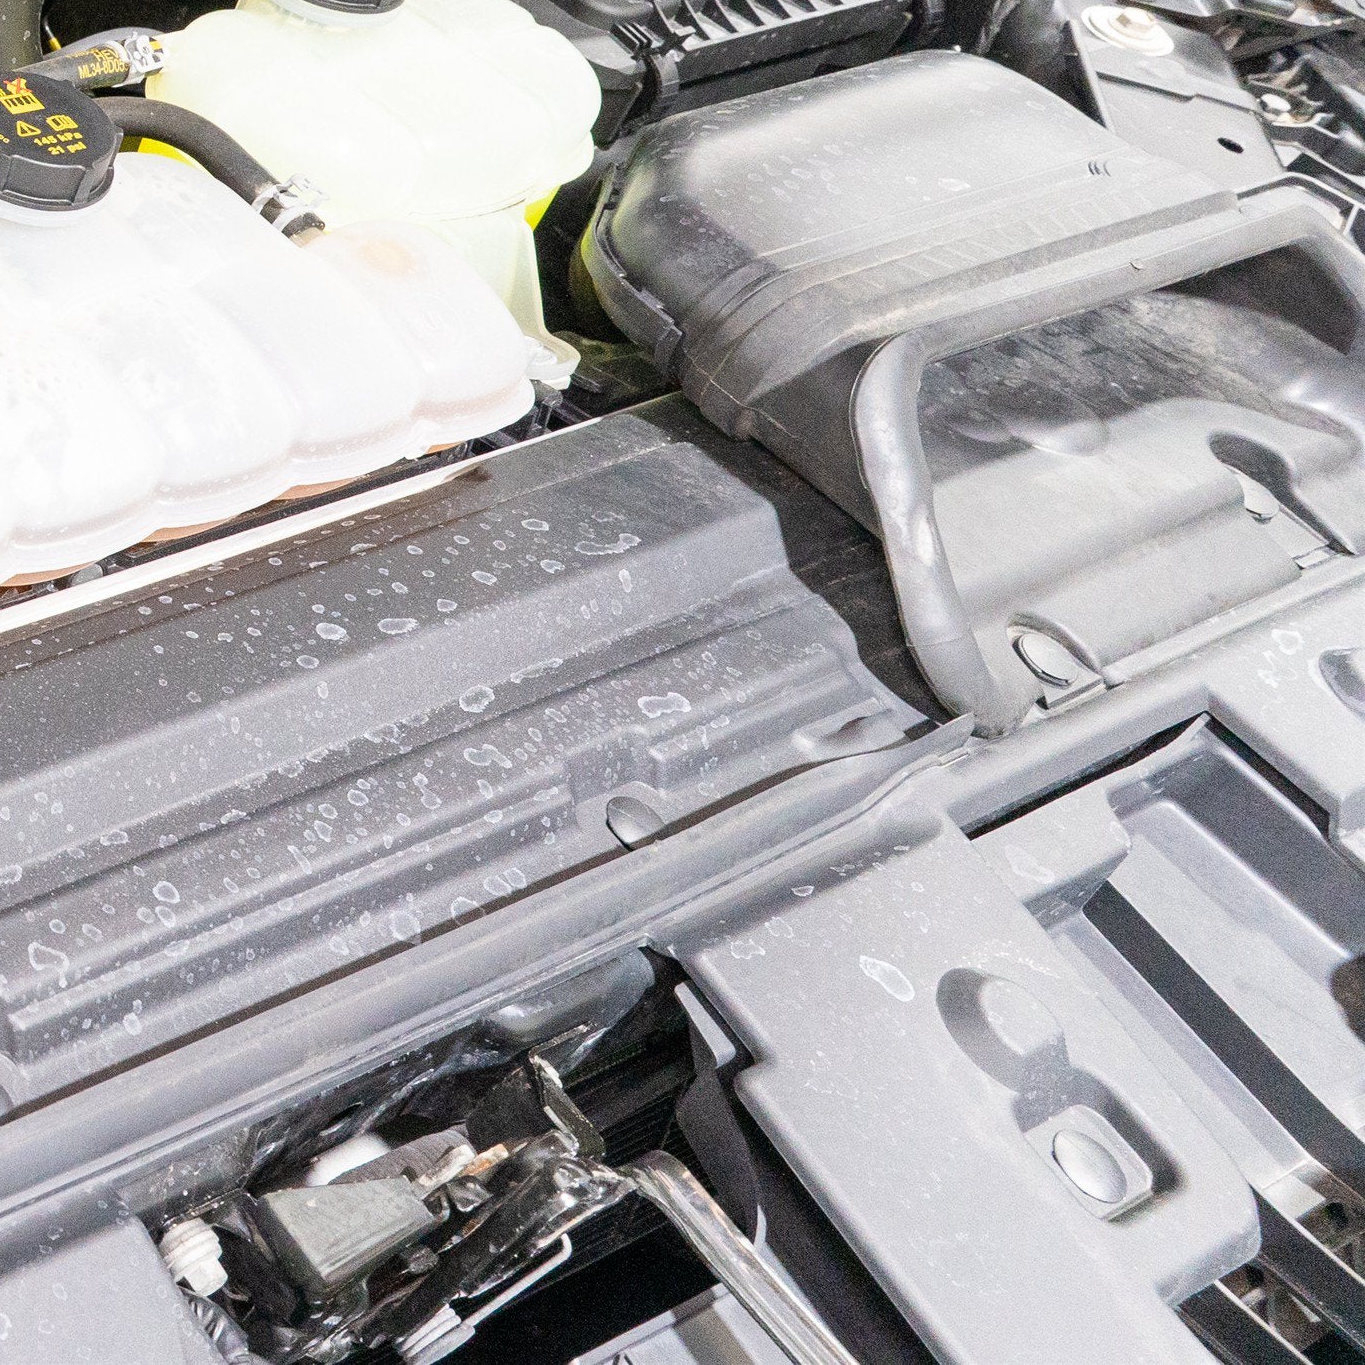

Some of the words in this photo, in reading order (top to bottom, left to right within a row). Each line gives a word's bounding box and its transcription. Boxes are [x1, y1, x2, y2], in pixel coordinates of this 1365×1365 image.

[92, 46, 120, 62] HEV
[34, 136, 57, 145] 145
[56, 133, 82, 142] kPa
[48, 147, 65, 155] 21
[66, 143, 86, 154] psi
